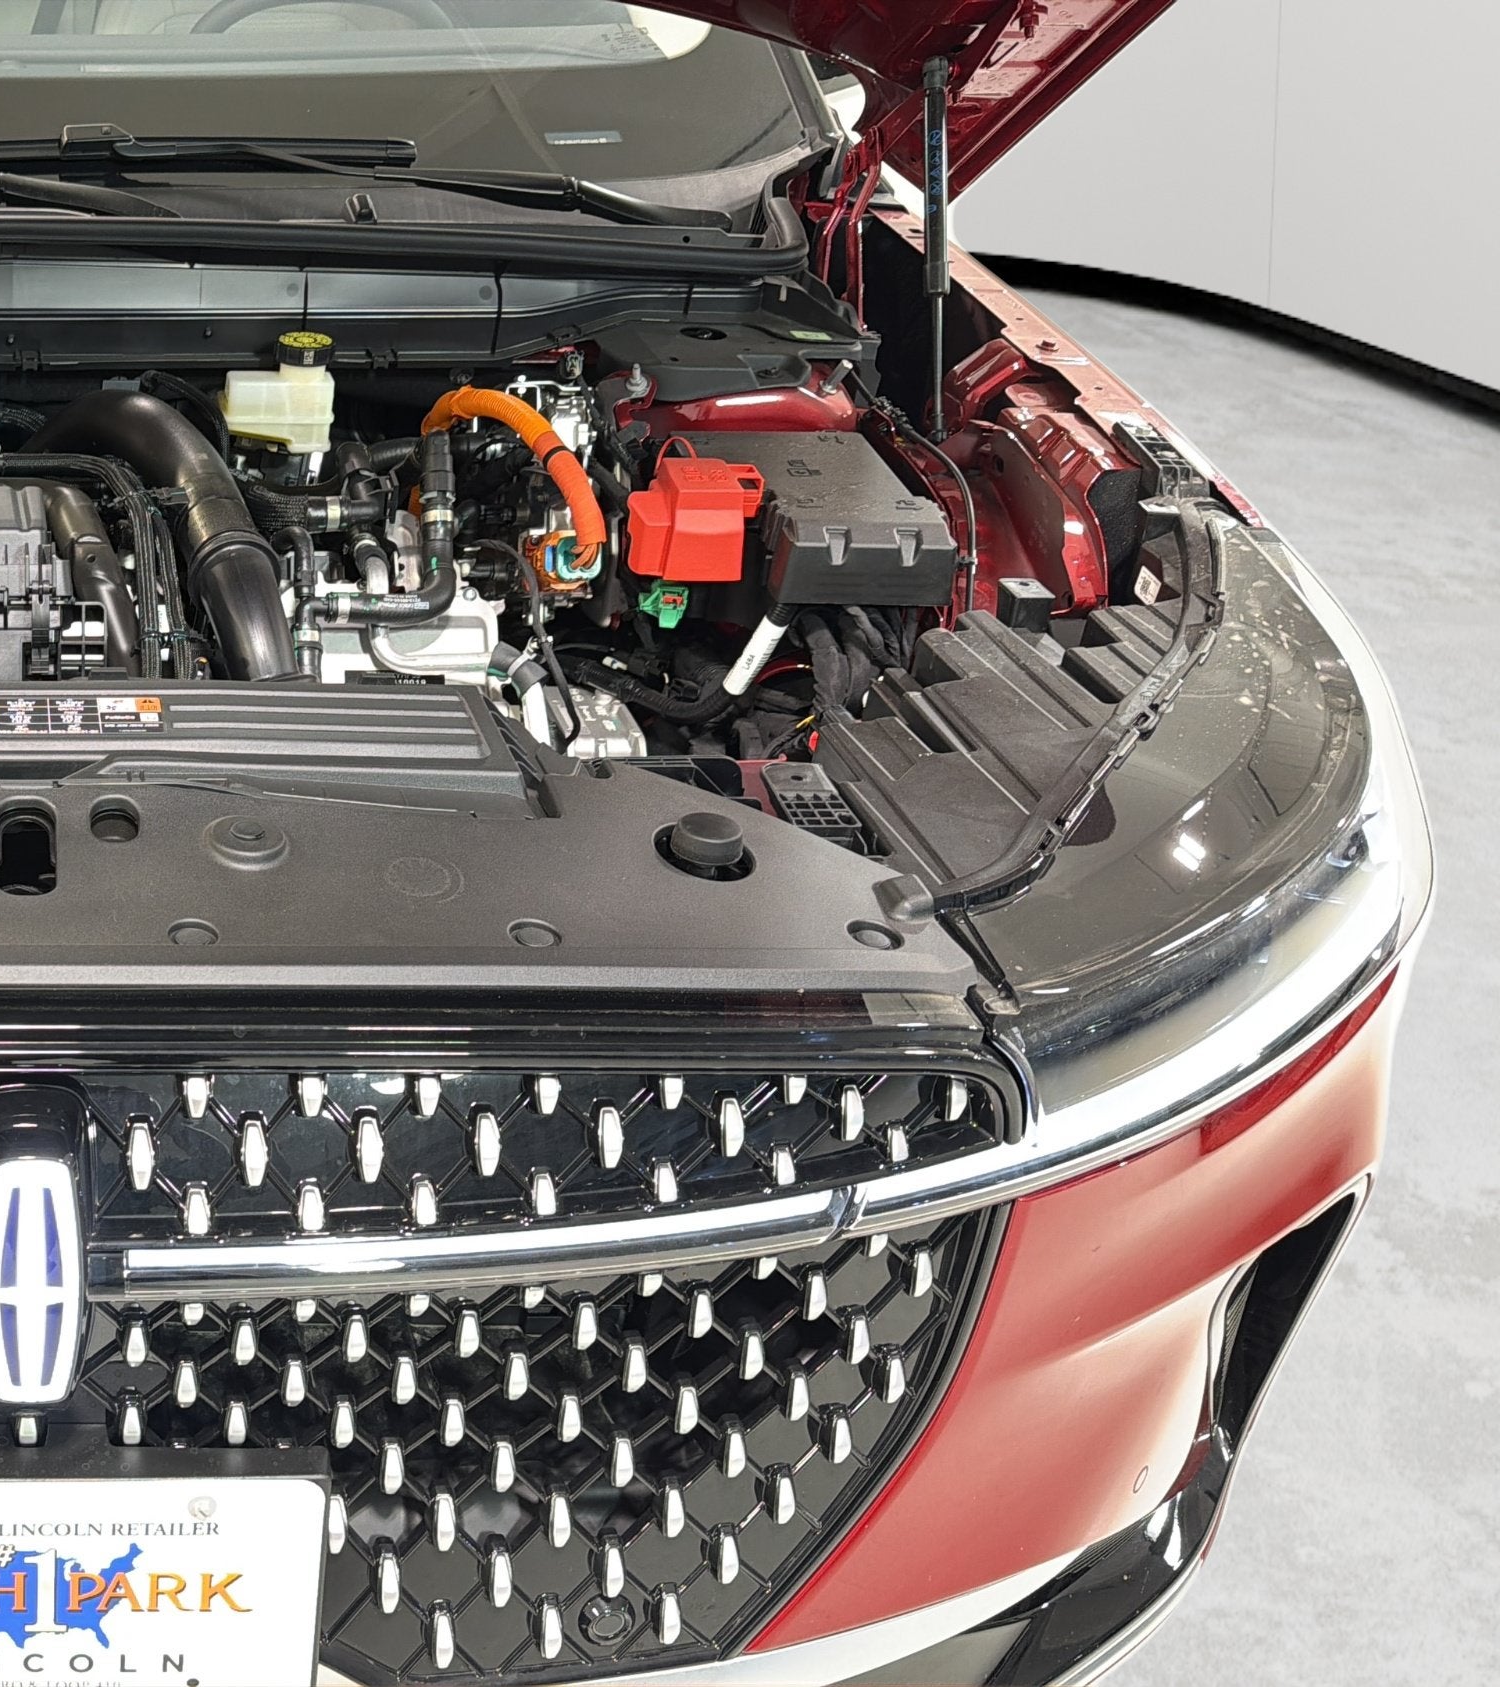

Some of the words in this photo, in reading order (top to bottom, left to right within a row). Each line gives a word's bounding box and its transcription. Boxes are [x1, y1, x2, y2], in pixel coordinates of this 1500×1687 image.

[0, 1522, 103, 1537] LINCOLN
[110, 1521, 220, 1537] RETAILER
[66, 1571, 254, 1613] PARK
